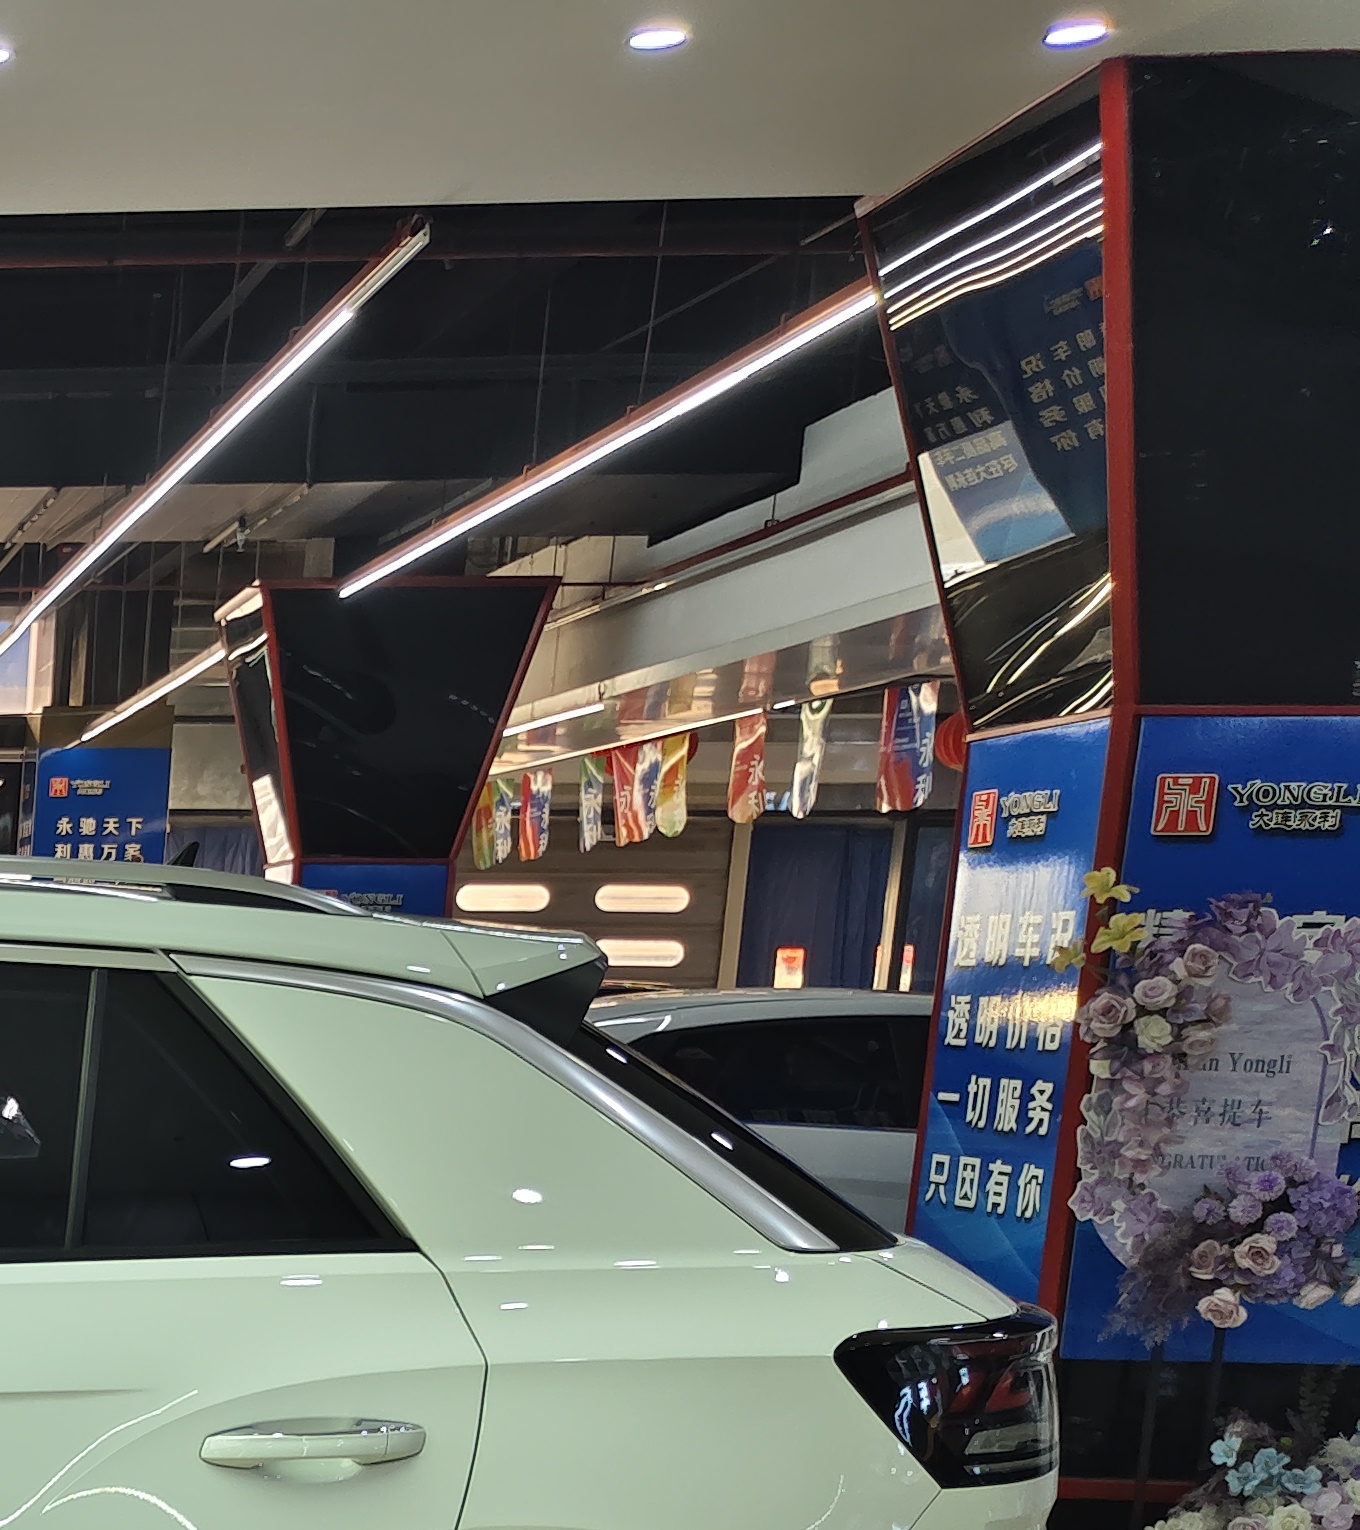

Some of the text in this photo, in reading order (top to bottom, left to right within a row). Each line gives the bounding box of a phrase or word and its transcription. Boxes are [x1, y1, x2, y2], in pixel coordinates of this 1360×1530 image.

[999, 789, 1061, 818] YONGLI
[55, 816, 144, 837] 永驰天下
[1248, 808, 1342, 832] 大连永利
[953, 910, 1077, 967] 透明车况
[1228, 1052, 1293, 1078] Yongli
[936, 1074, 1055, 1136] 一切服务
[924, 1153, 1045, 1219] 只因有你
